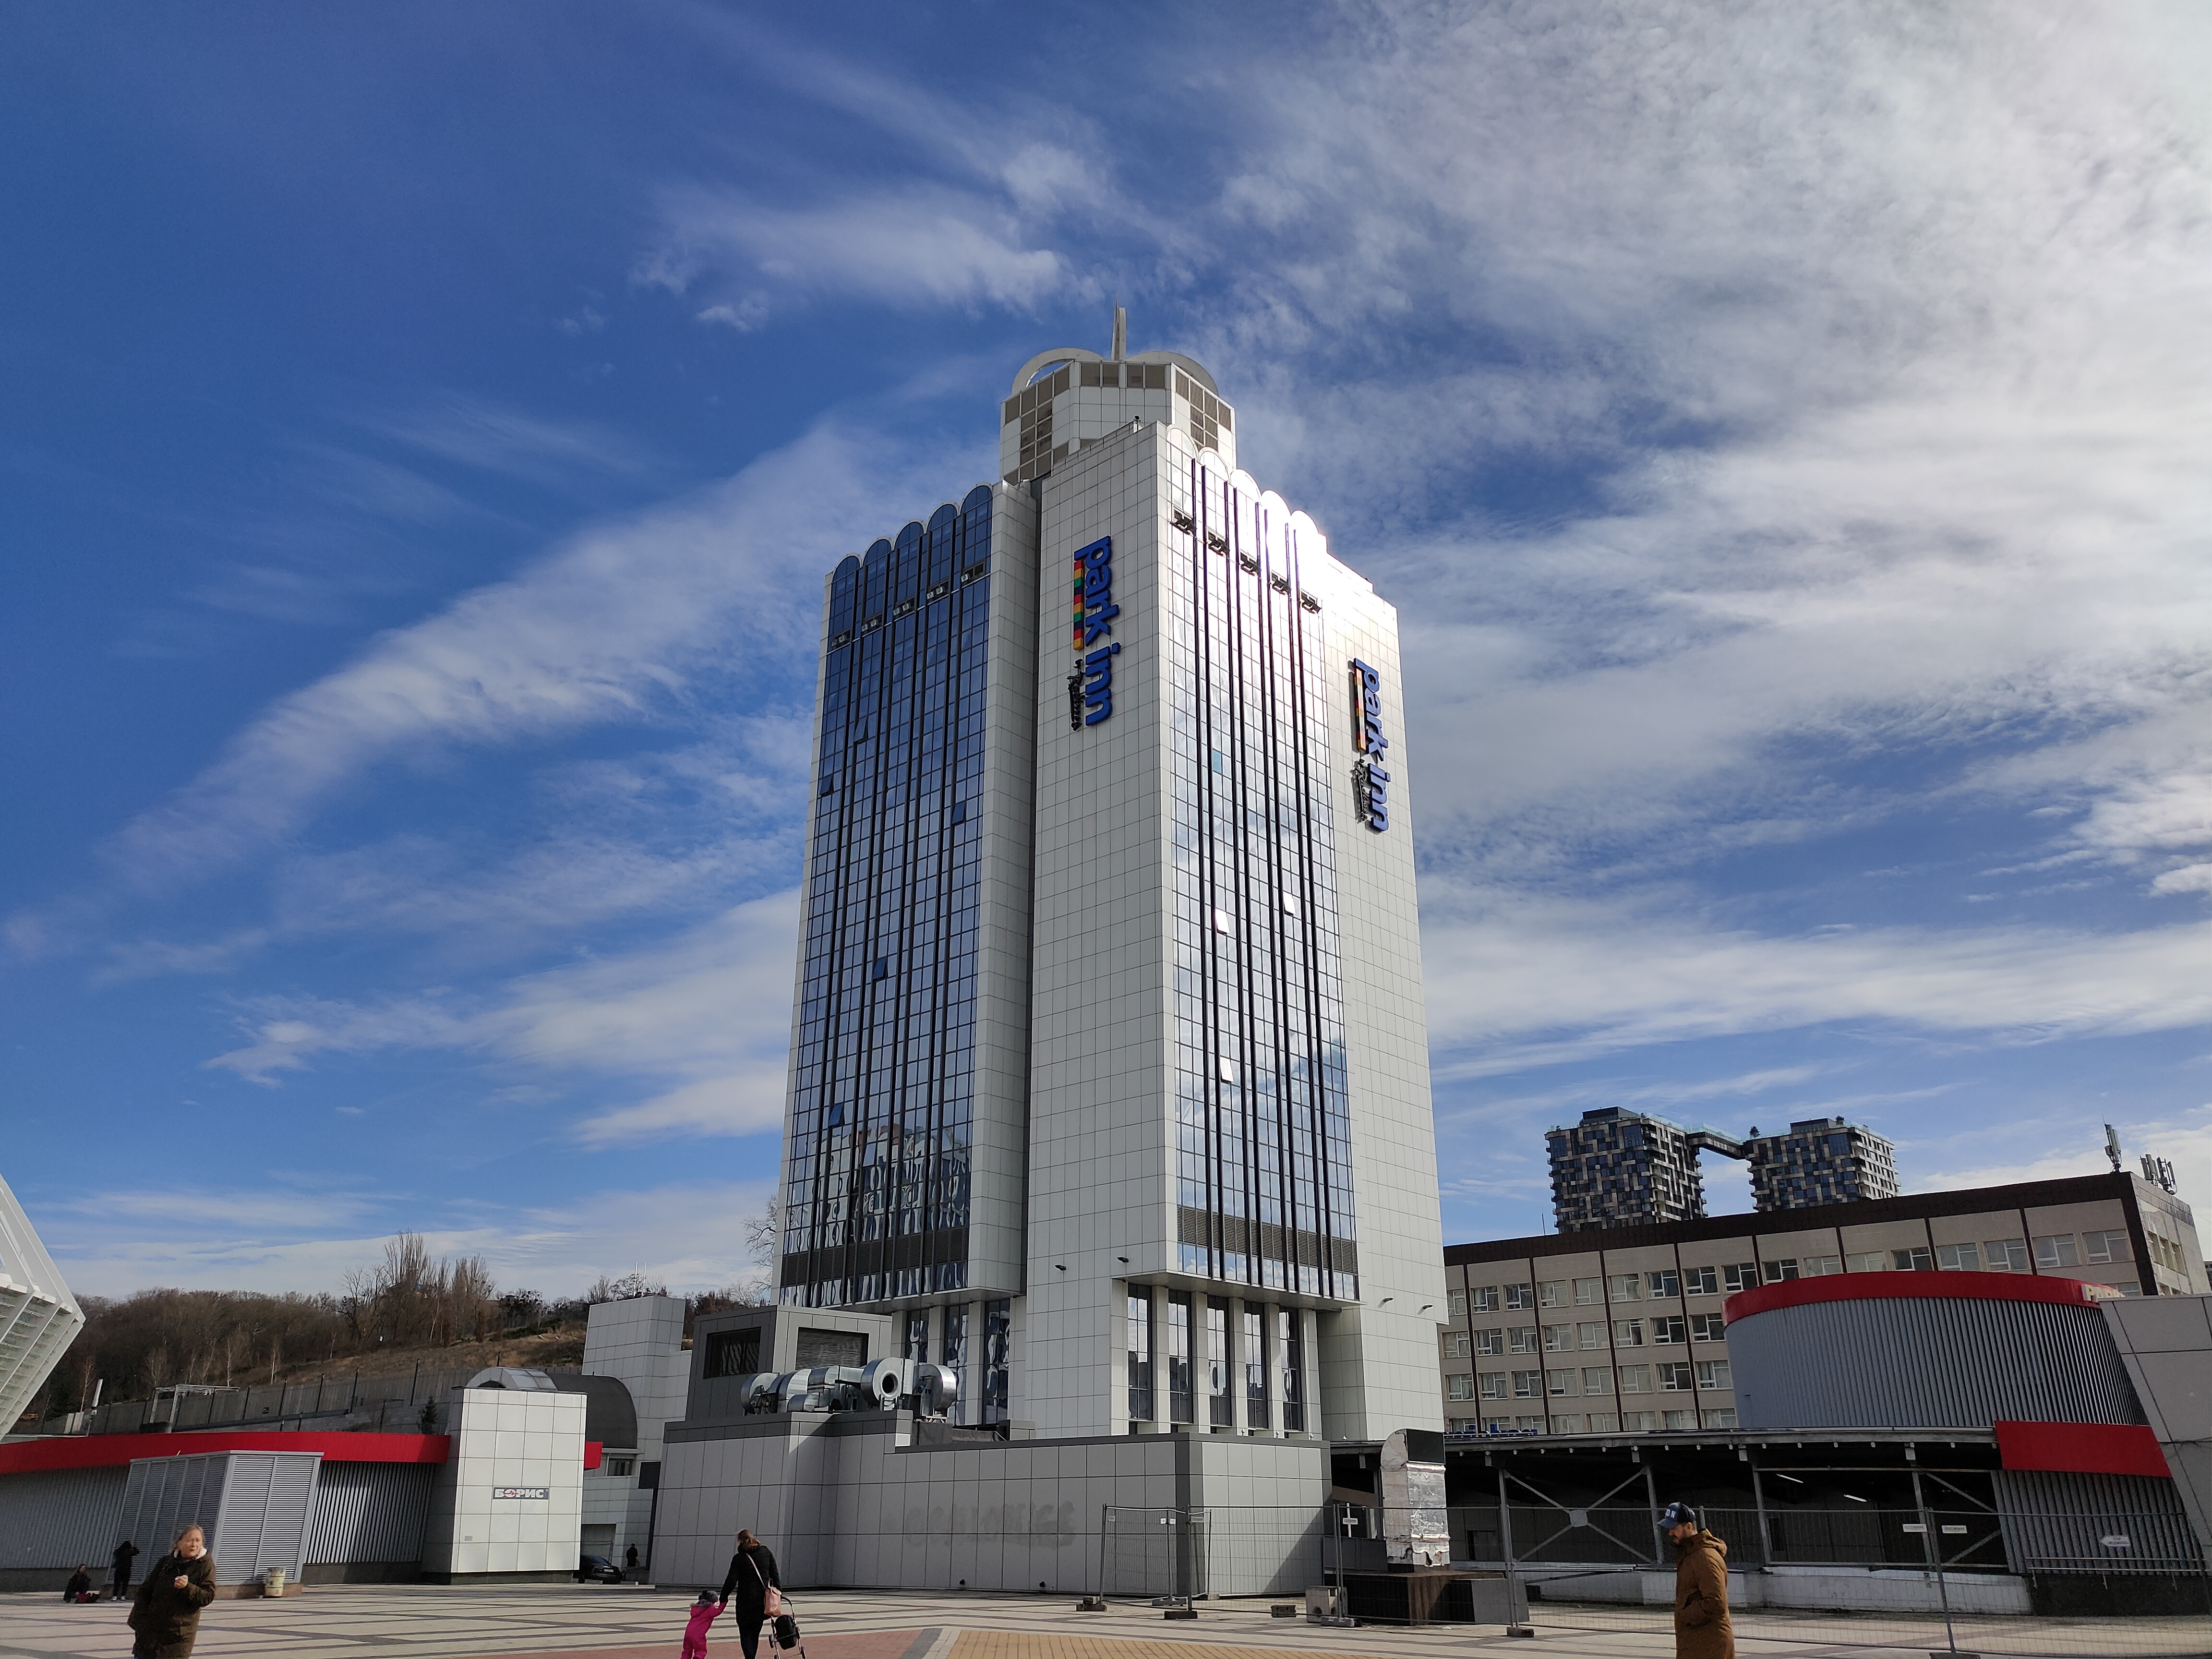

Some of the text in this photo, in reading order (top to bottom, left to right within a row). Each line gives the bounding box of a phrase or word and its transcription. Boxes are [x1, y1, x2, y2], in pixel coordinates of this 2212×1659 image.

[1074, 535, 1121, 726] park inn
[1353, 658, 1391, 831] park inn
[494, 1489, 544, 1498] БОРИС
